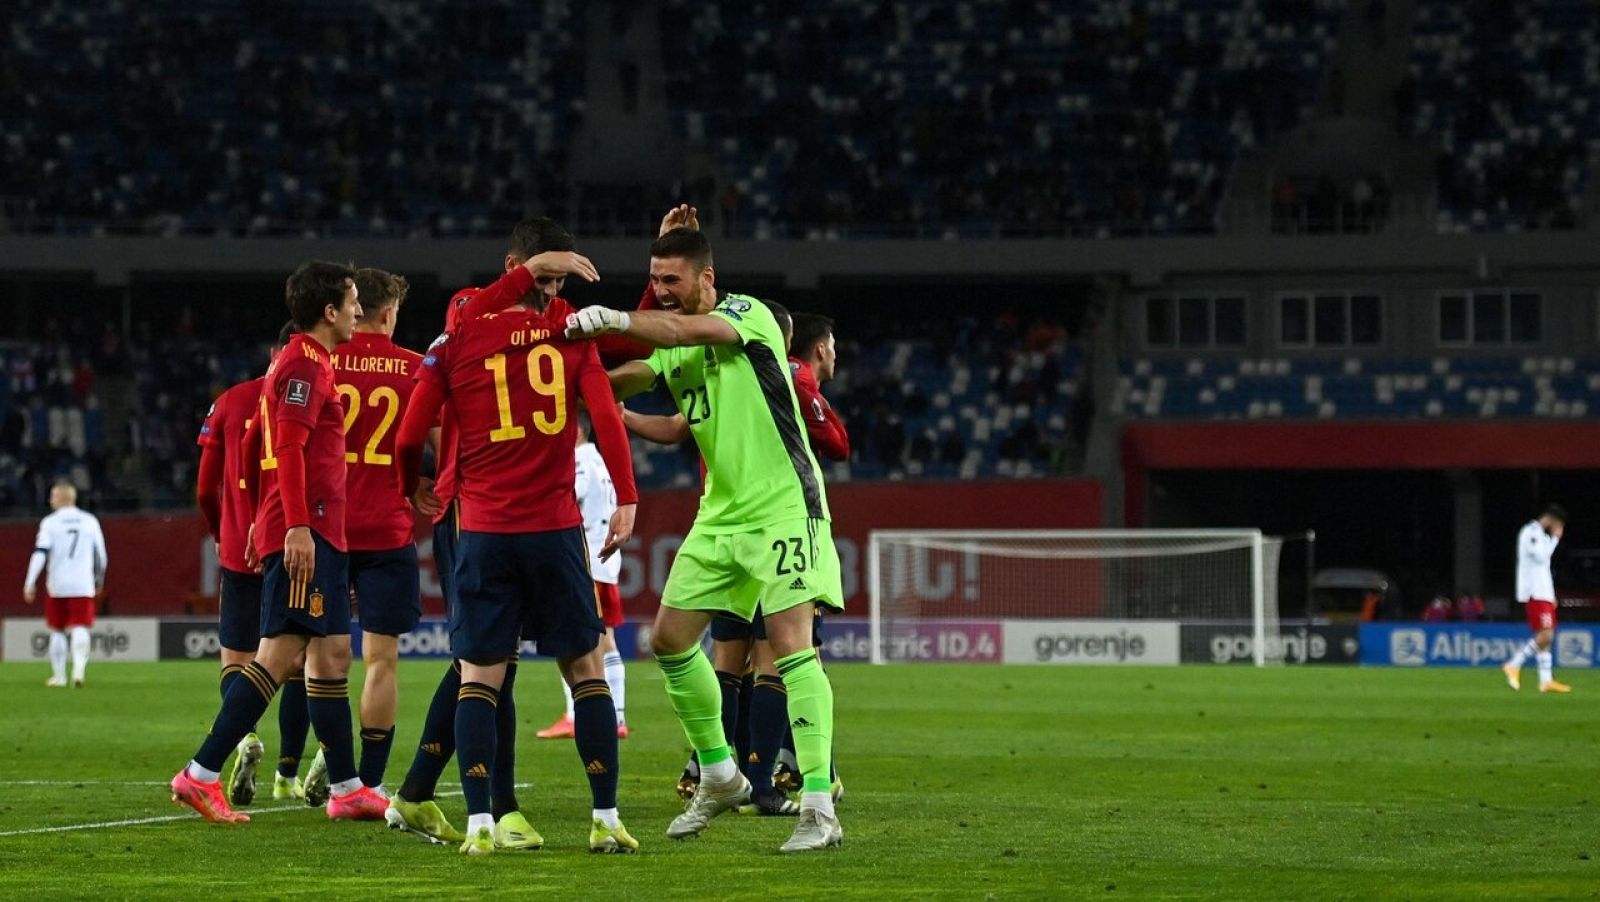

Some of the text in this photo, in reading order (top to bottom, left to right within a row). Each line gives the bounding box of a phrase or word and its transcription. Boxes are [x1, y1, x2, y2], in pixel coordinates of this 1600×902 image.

[345, 354, 409, 376] LLORENTE
[484, 343, 567, 443] 19
[681, 384, 712, 426] 23
[336, 383, 400, 465] 22
[66, 530, 79, 559] 7
[772, 537, 806, 576] 23
[938, 630, 996, 659] ID.4
[1035, 624, 1146, 662] gorenje
[1210, 627, 1327, 663] goenje
